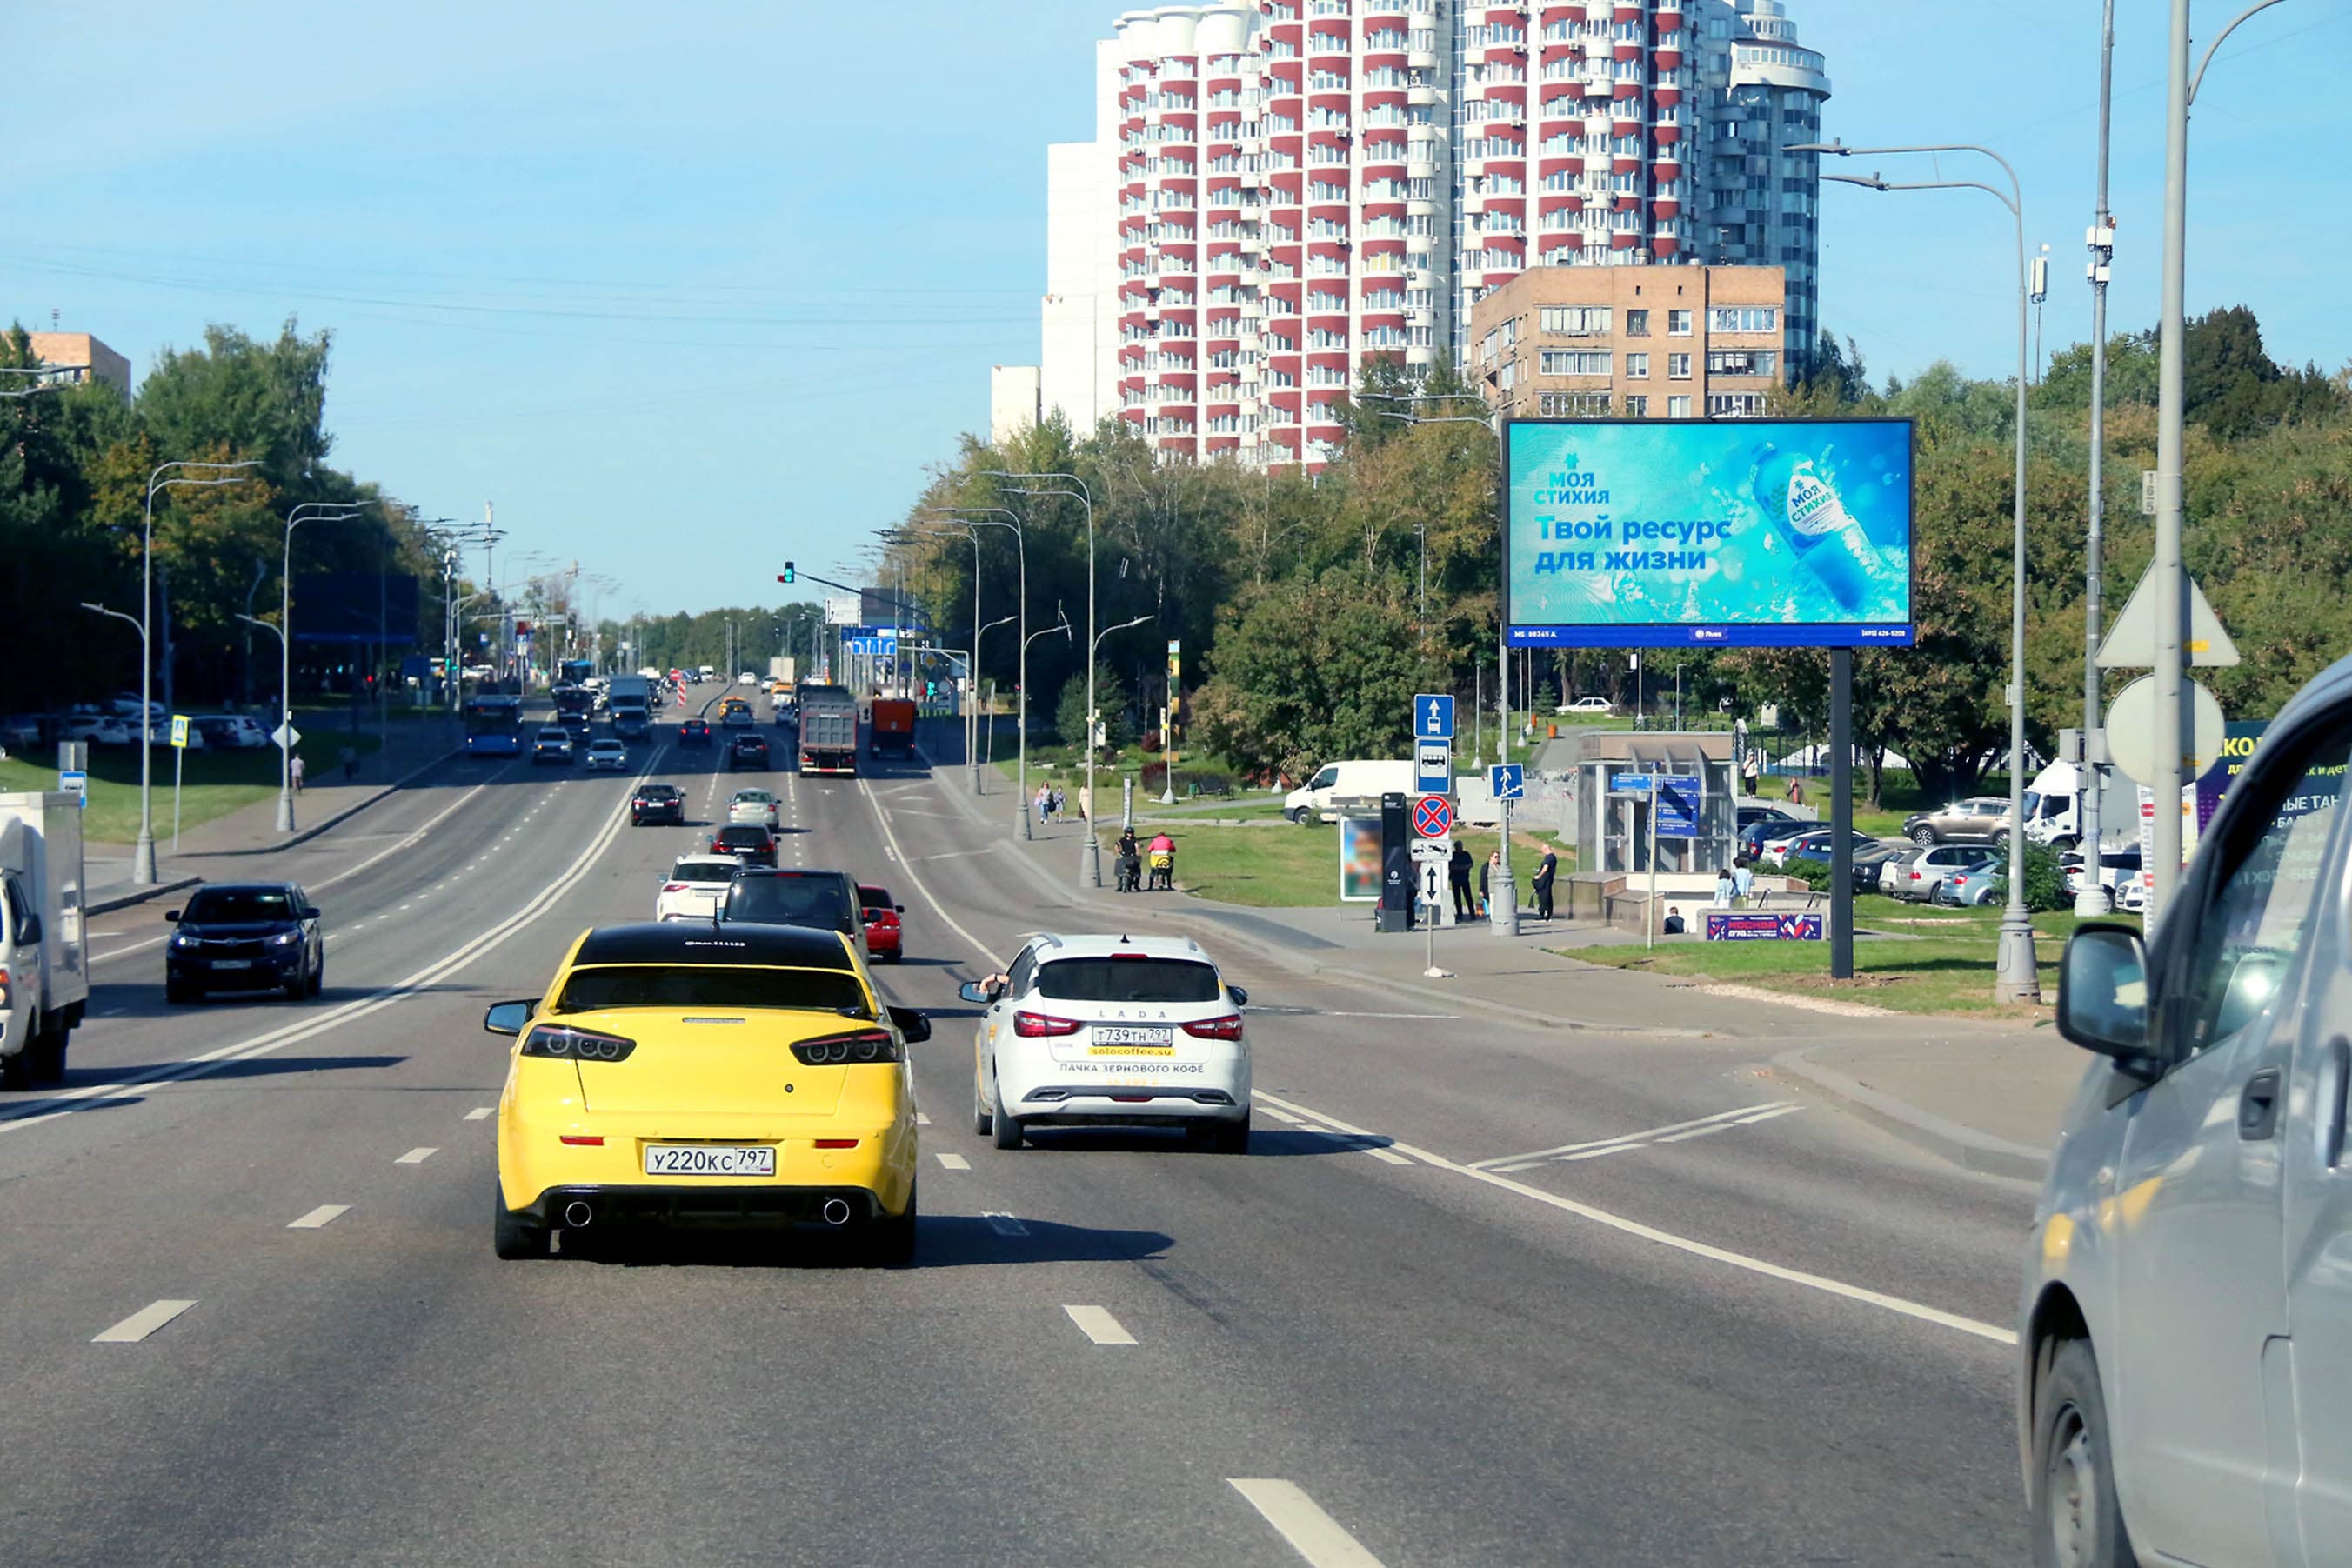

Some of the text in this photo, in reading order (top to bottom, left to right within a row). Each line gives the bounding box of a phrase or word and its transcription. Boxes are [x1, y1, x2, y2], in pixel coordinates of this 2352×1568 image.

[1549, 472, 1594, 487] МОЯ
[1533, 490, 1609, 504] СТИХИЯ
[1792, 485, 1821, 507] МОЯ
[1535, 514, 1732, 544] Твой ресурс
[1535, 551, 1706, 574] для жизни
[1099, 1010, 1166, 1018] LADA
[1098, 1029, 1166, 1041] Т739ТН 797
[1092, 1047, 1171, 1056] solocoffee.su
[1059, 1064, 1203, 1073] ПАЧКА ЗЕРНОВОГО КОФЕ
[655, 1151, 767, 1170] У220КС 797
